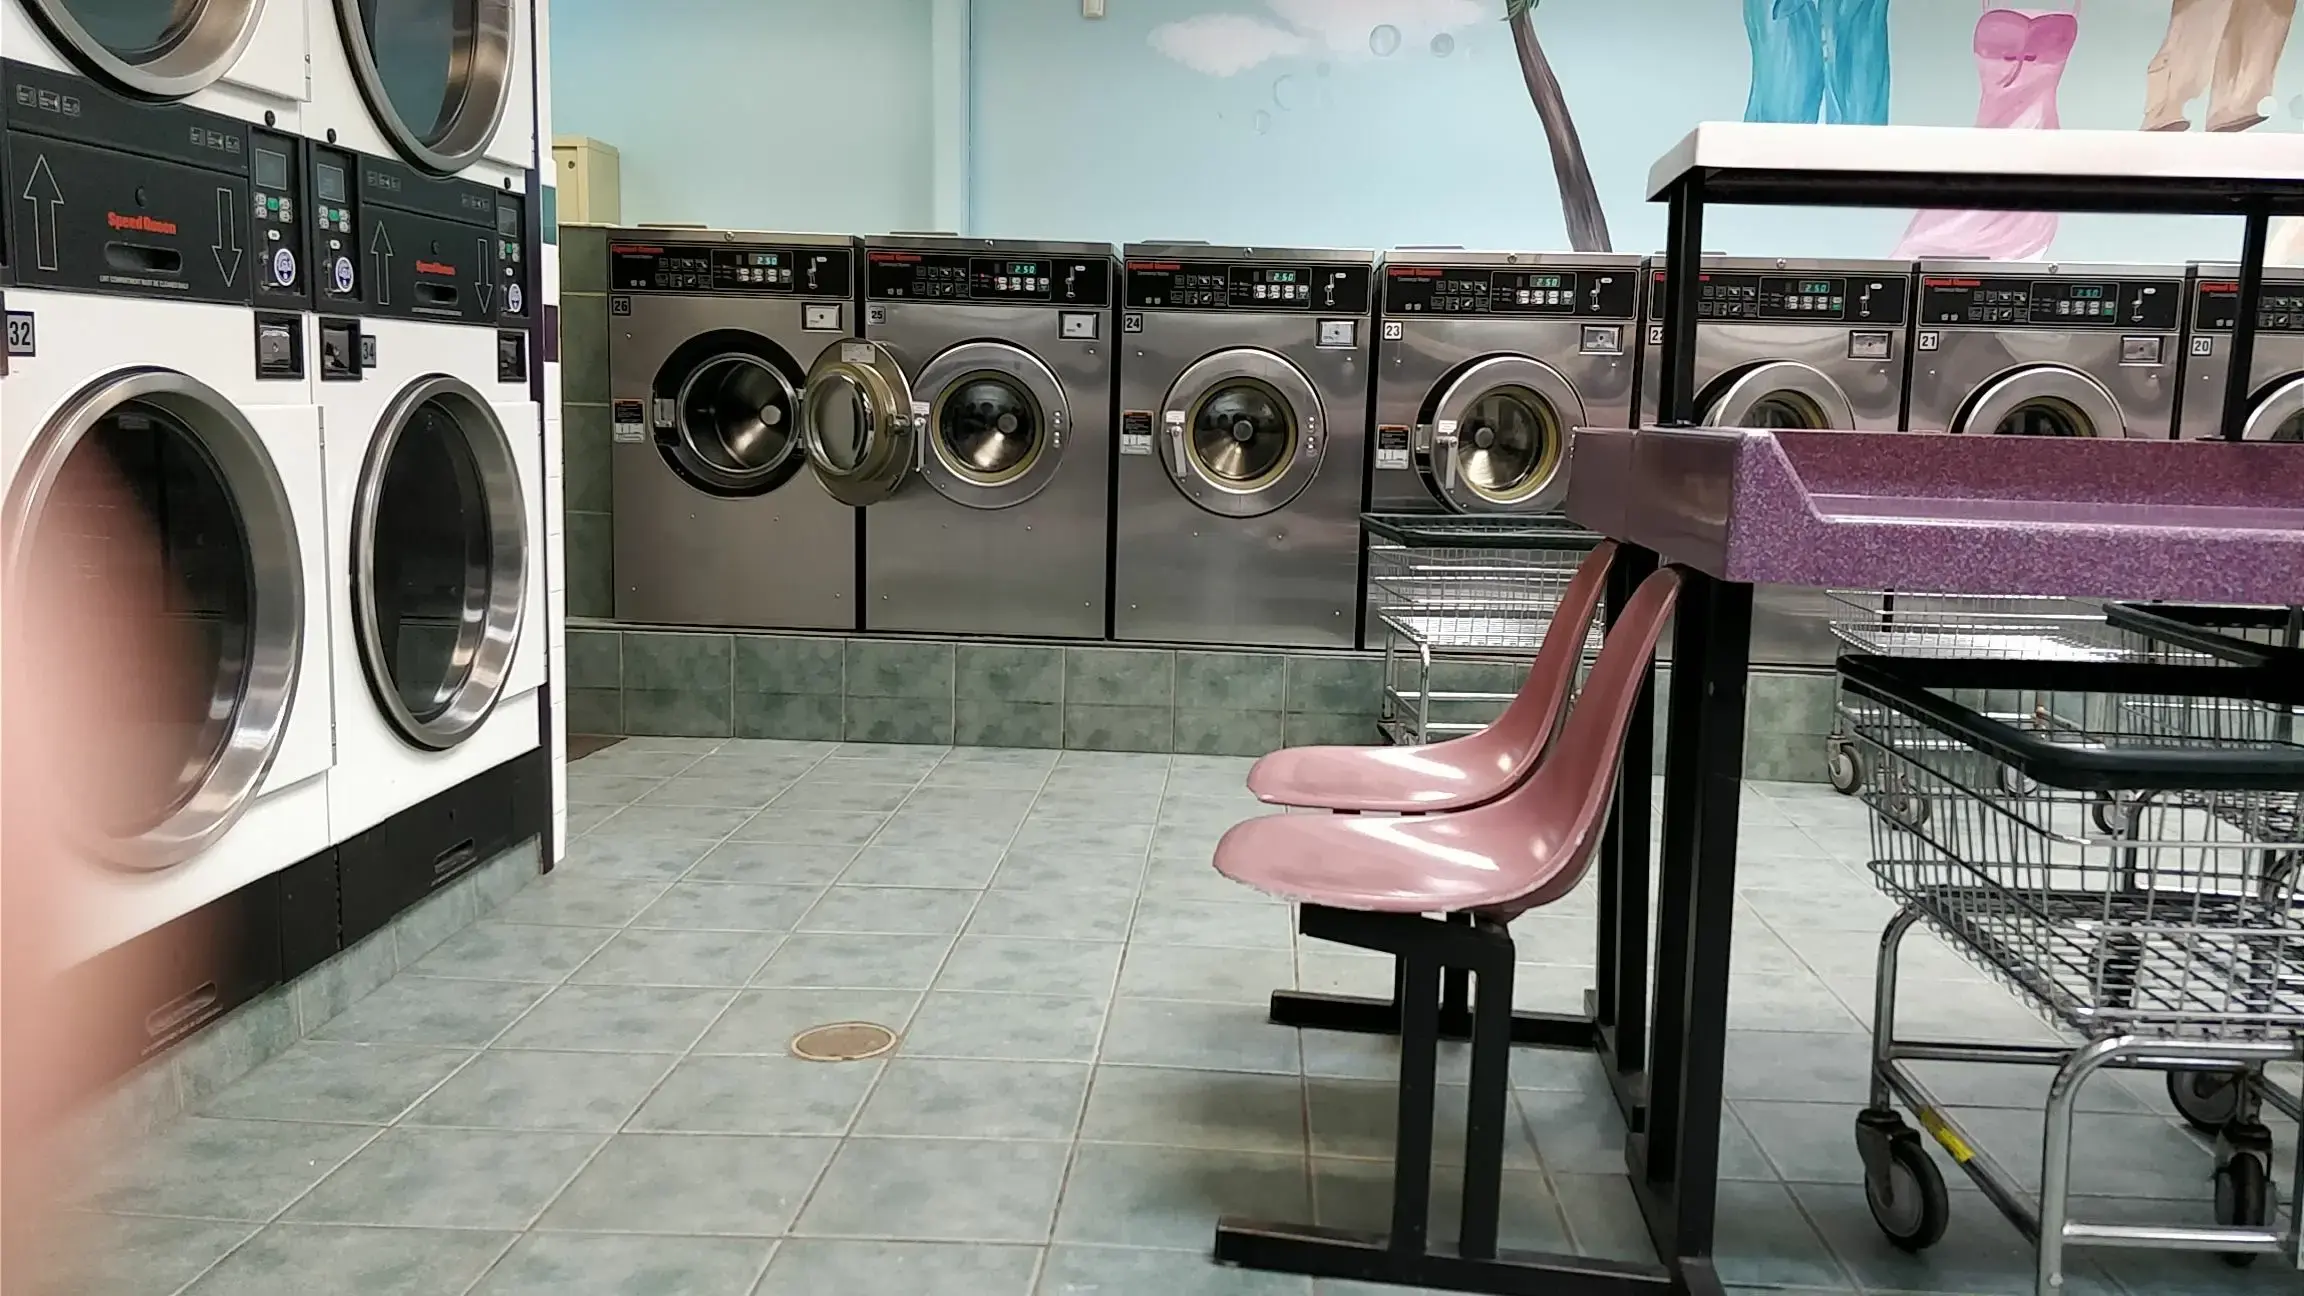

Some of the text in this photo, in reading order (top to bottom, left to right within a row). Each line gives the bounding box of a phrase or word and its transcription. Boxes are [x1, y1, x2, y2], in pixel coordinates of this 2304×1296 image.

[614, 300, 628, 312] 26
[871, 310, 883, 319] 25
[1126, 317, 1140, 329] 24
[9, 321, 31, 346] 32
[1386, 325, 1400, 337] 23
[1922, 335, 1936, 347] 21
[2194, 340, 2209, 352] 20
